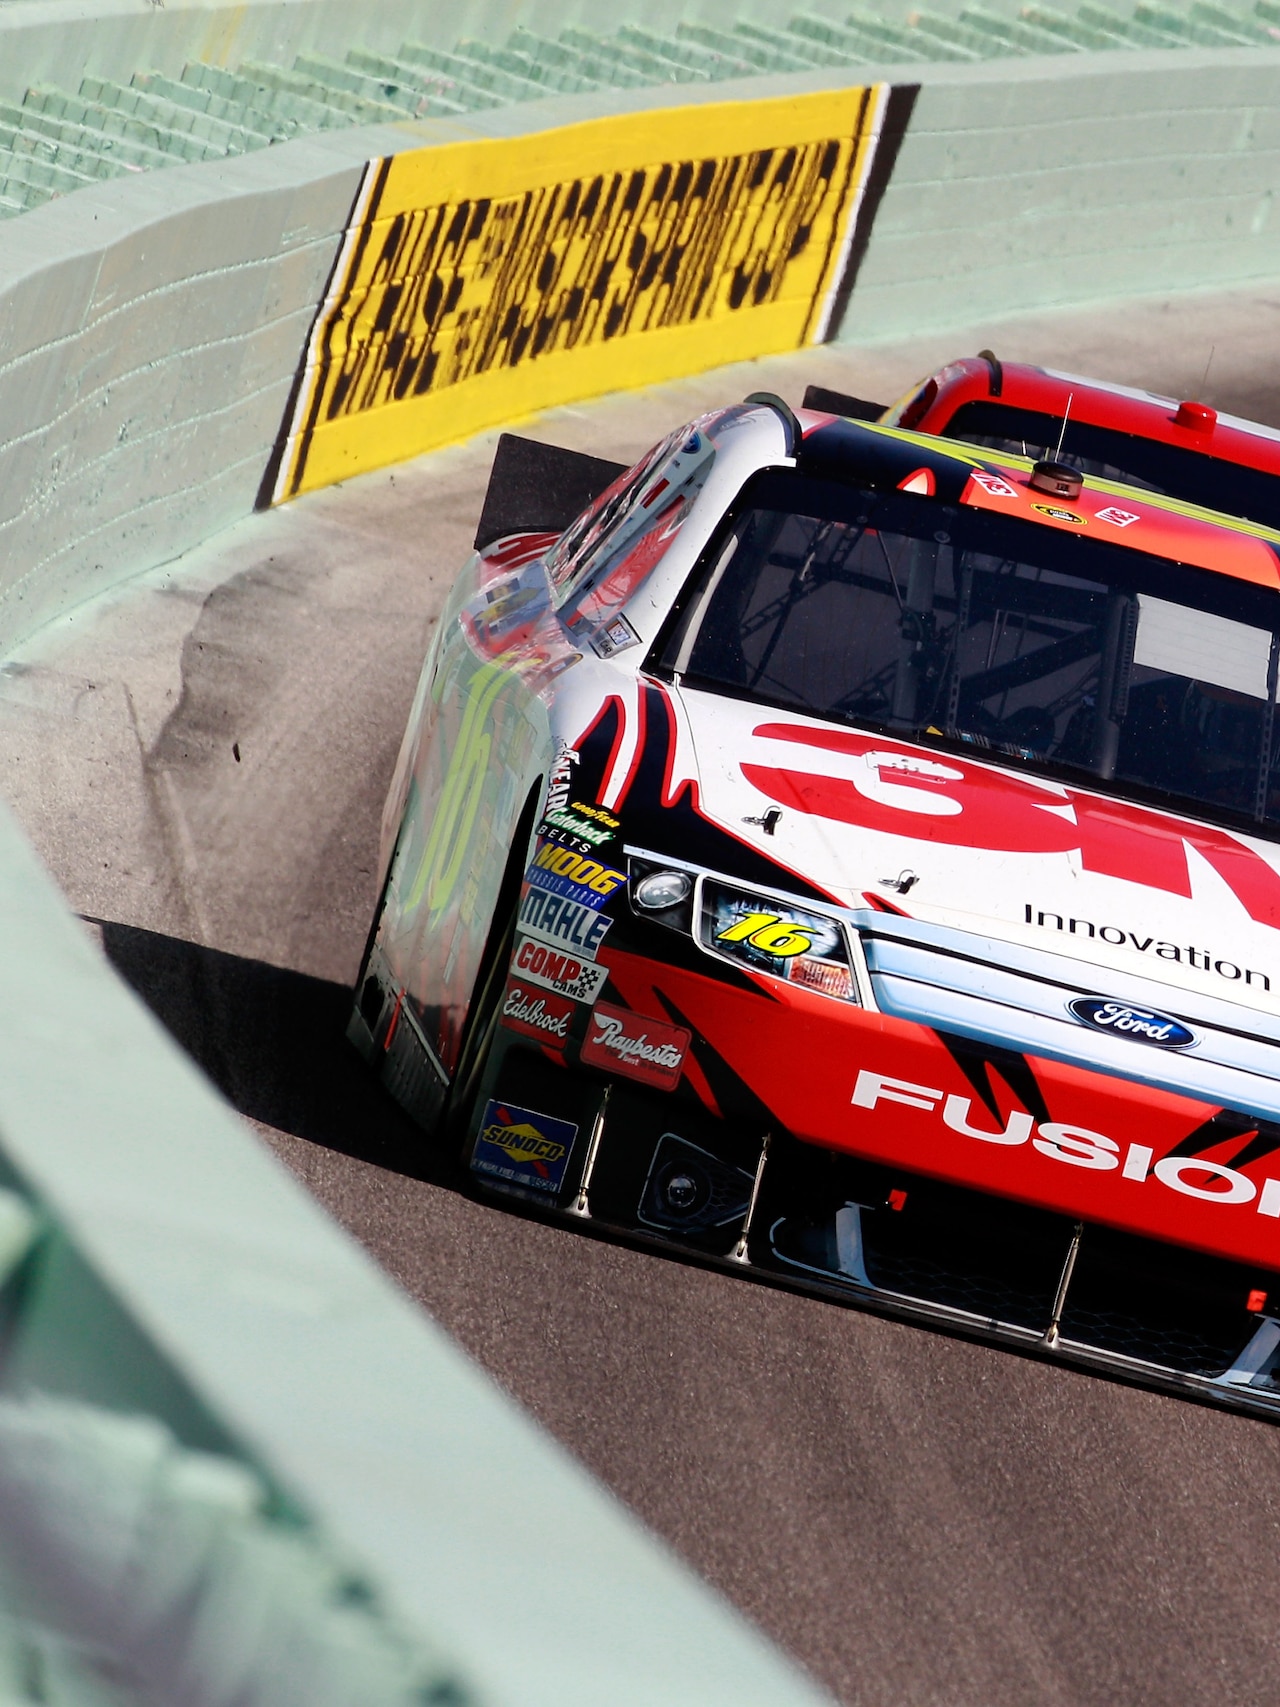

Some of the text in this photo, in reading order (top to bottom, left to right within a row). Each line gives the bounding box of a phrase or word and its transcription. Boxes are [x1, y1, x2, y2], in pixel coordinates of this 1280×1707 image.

[538, 824, 592, 853] BELTS
[545, 806, 613, 846] Gatorback
[526, 869, 600, 907] CHASSIS PARTS
[532, 842, 627, 895] MOOG
[520, 886, 613, 951] MAHLE
[717, 912, 820, 957] 16
[517, 942, 582, 982] COMP
[1024, 902, 1271, 993] Innovation
[552, 979, 587, 999] CAMS
[503, 989, 571, 1037] Edelbrock
[1093, 1000, 1173, 1041] Ford
[593, 1012, 682, 1068] Raybestos
[486, 1127, 562, 1159] SUNOCO
